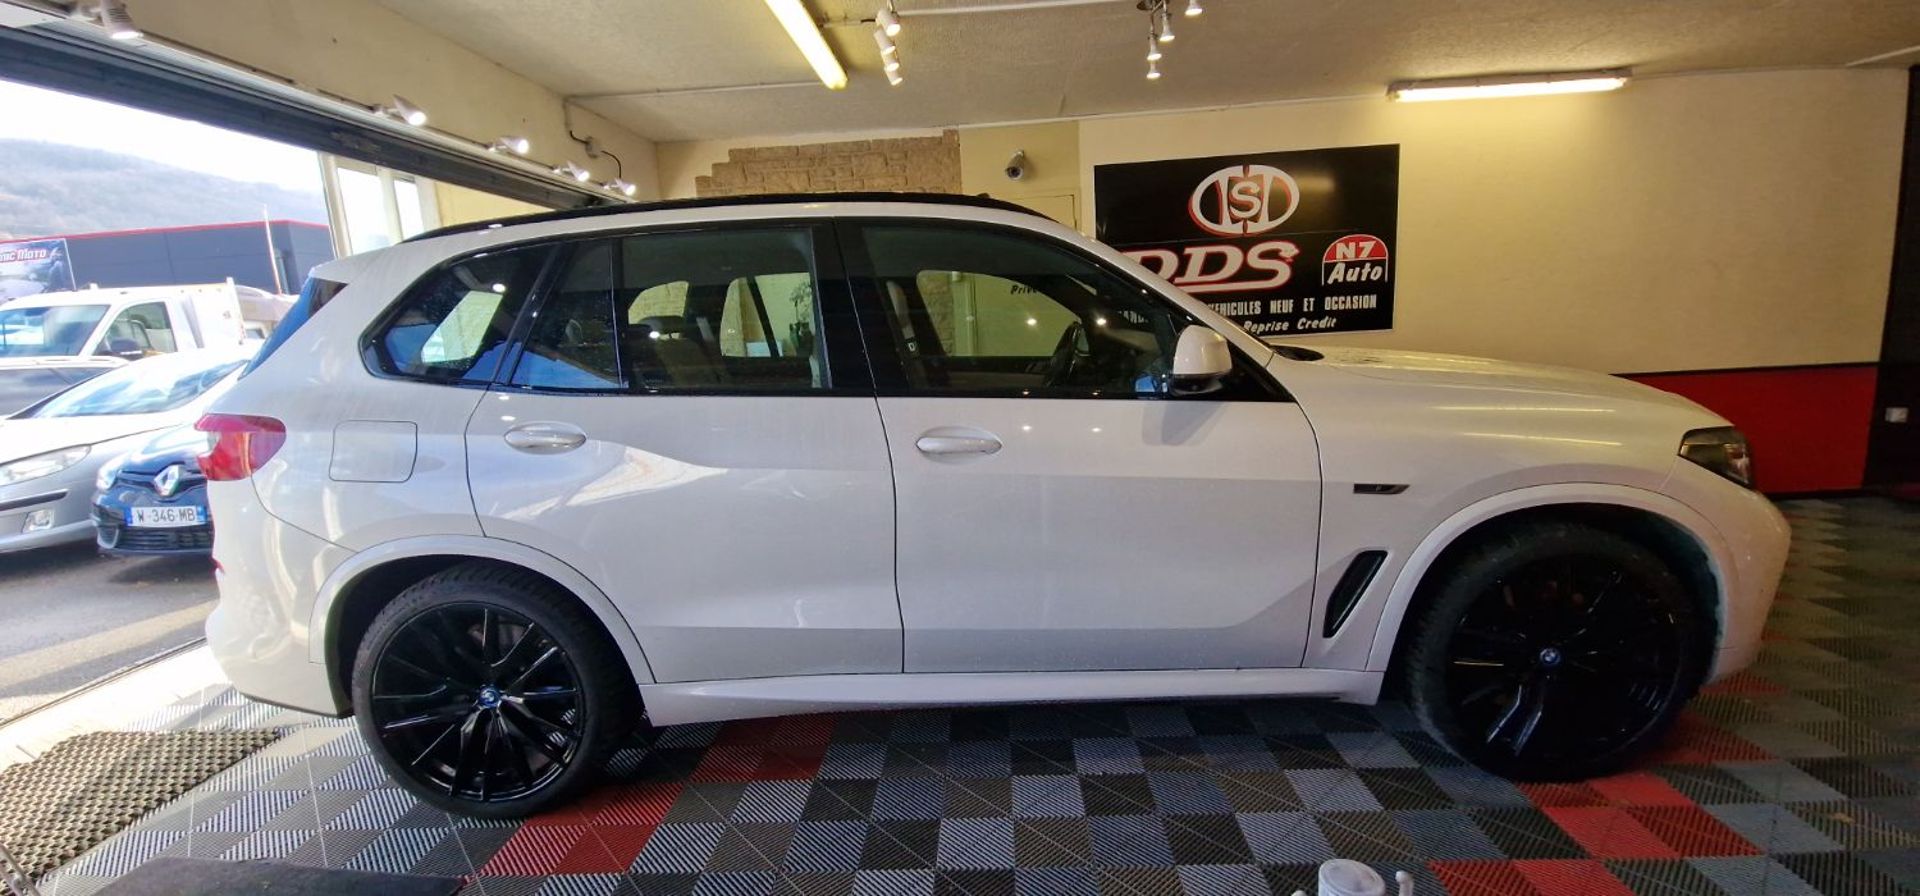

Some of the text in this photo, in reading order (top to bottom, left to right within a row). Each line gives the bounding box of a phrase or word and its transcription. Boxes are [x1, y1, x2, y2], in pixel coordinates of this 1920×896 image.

[1336, 241, 1377, 262] N7
[1326, 263, 1383, 284] Auto
[1269, 299, 1295, 315] NEUF
[1303, 297, 1316, 312] ET
[1325, 294, 1377, 311] OCCASION
[1243, 315, 1337, 335] Reprise Credit
